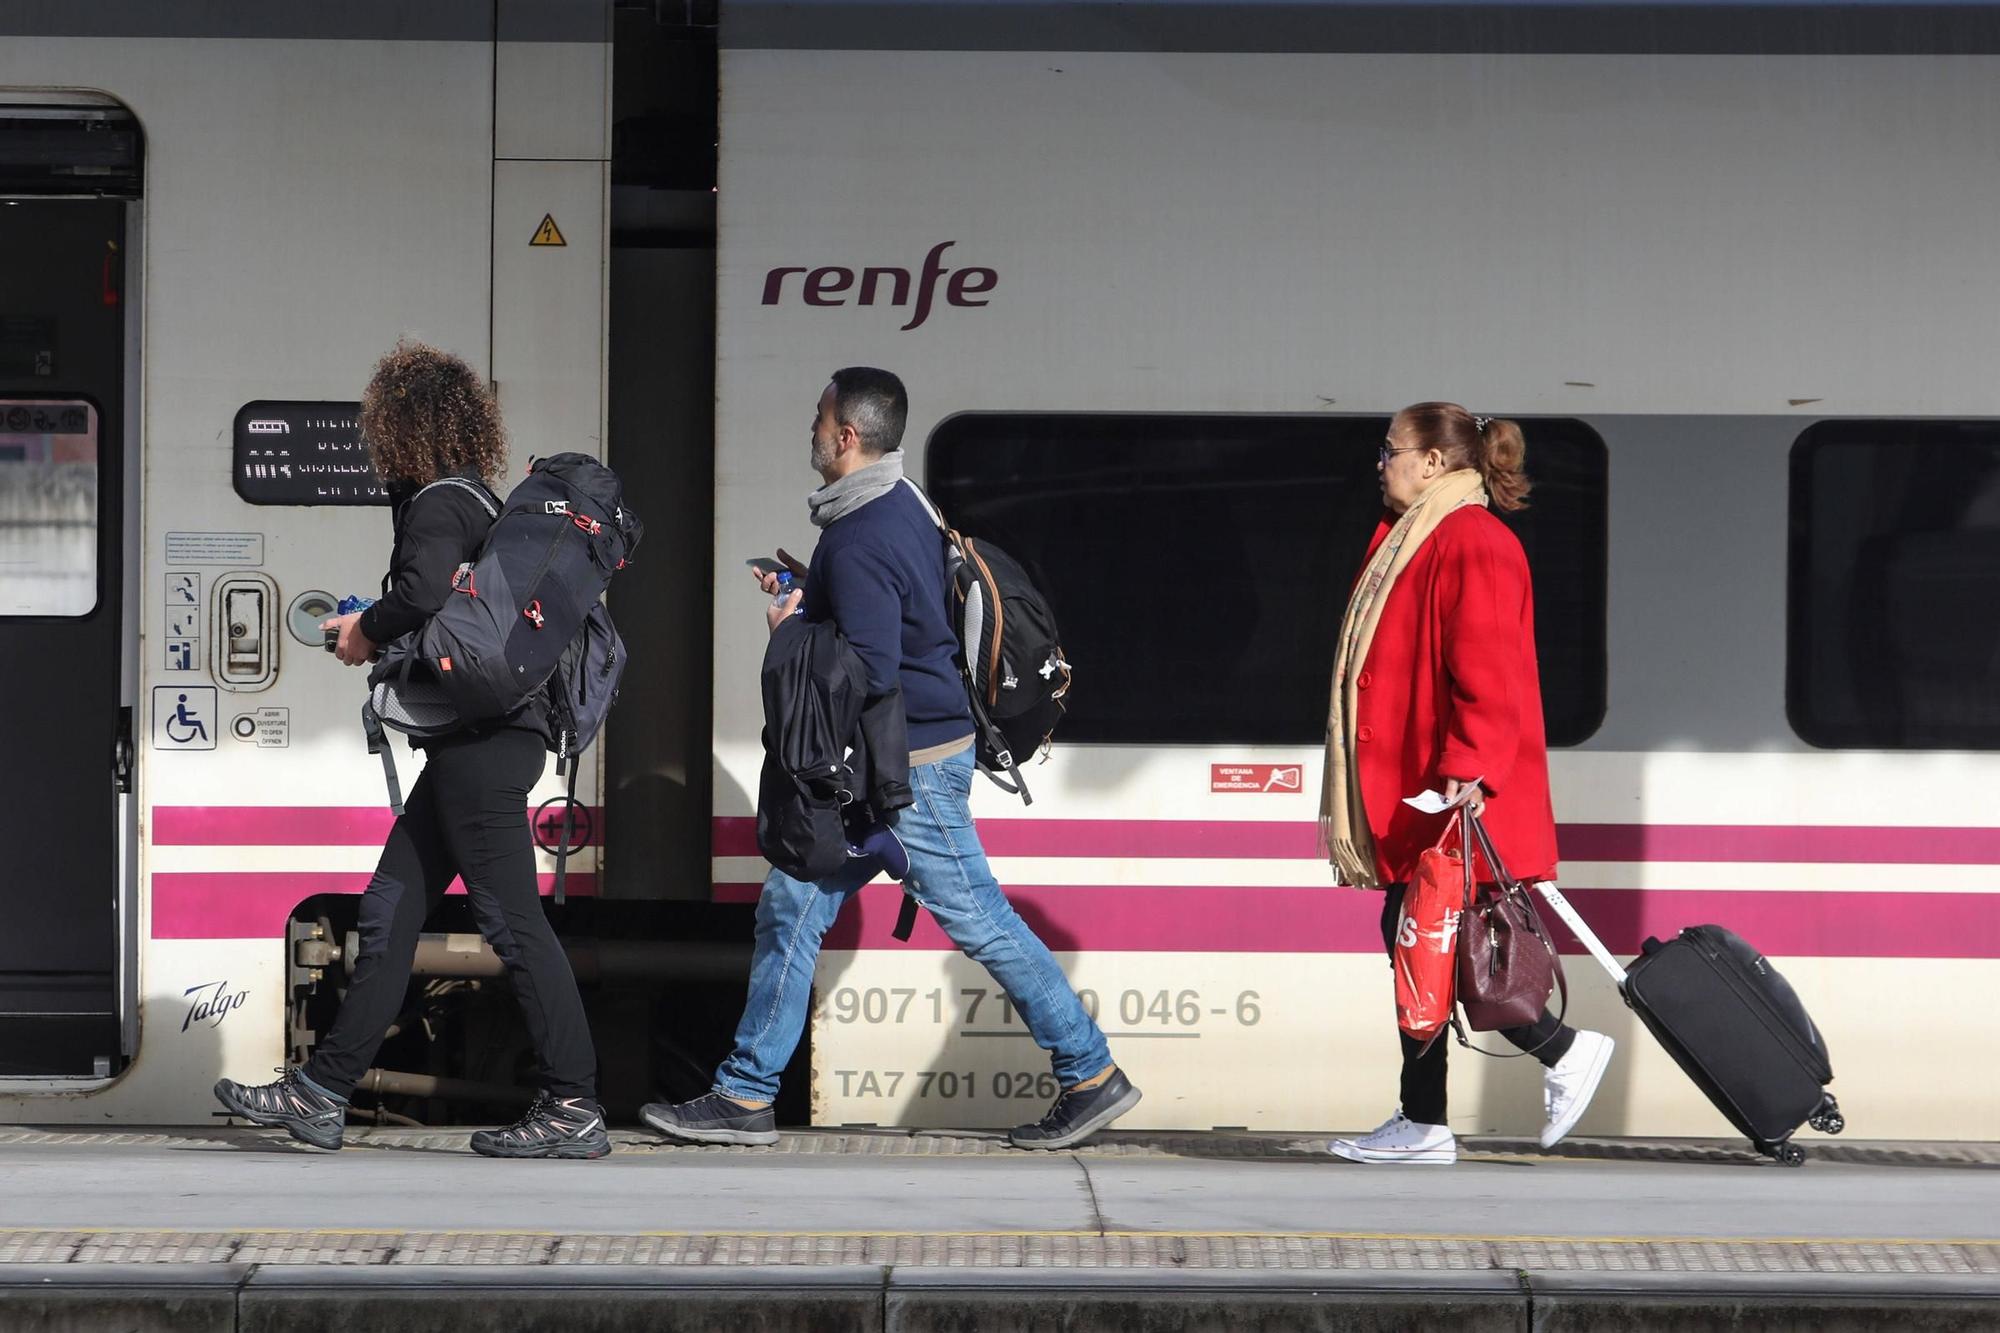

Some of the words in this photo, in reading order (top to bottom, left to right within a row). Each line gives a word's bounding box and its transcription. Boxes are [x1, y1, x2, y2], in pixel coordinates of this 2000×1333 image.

[760, 240, 999, 332] renfe
[559, 730, 567, 759] Quechua
[1219, 767, 1254, 775] VENTANA
[181, 980, 250, 1033] Talgo
[834, 1070, 905, 1098] TA7
[916, 1071, 975, 1098] 701
[992, 1071, 1057, 1099] 026
